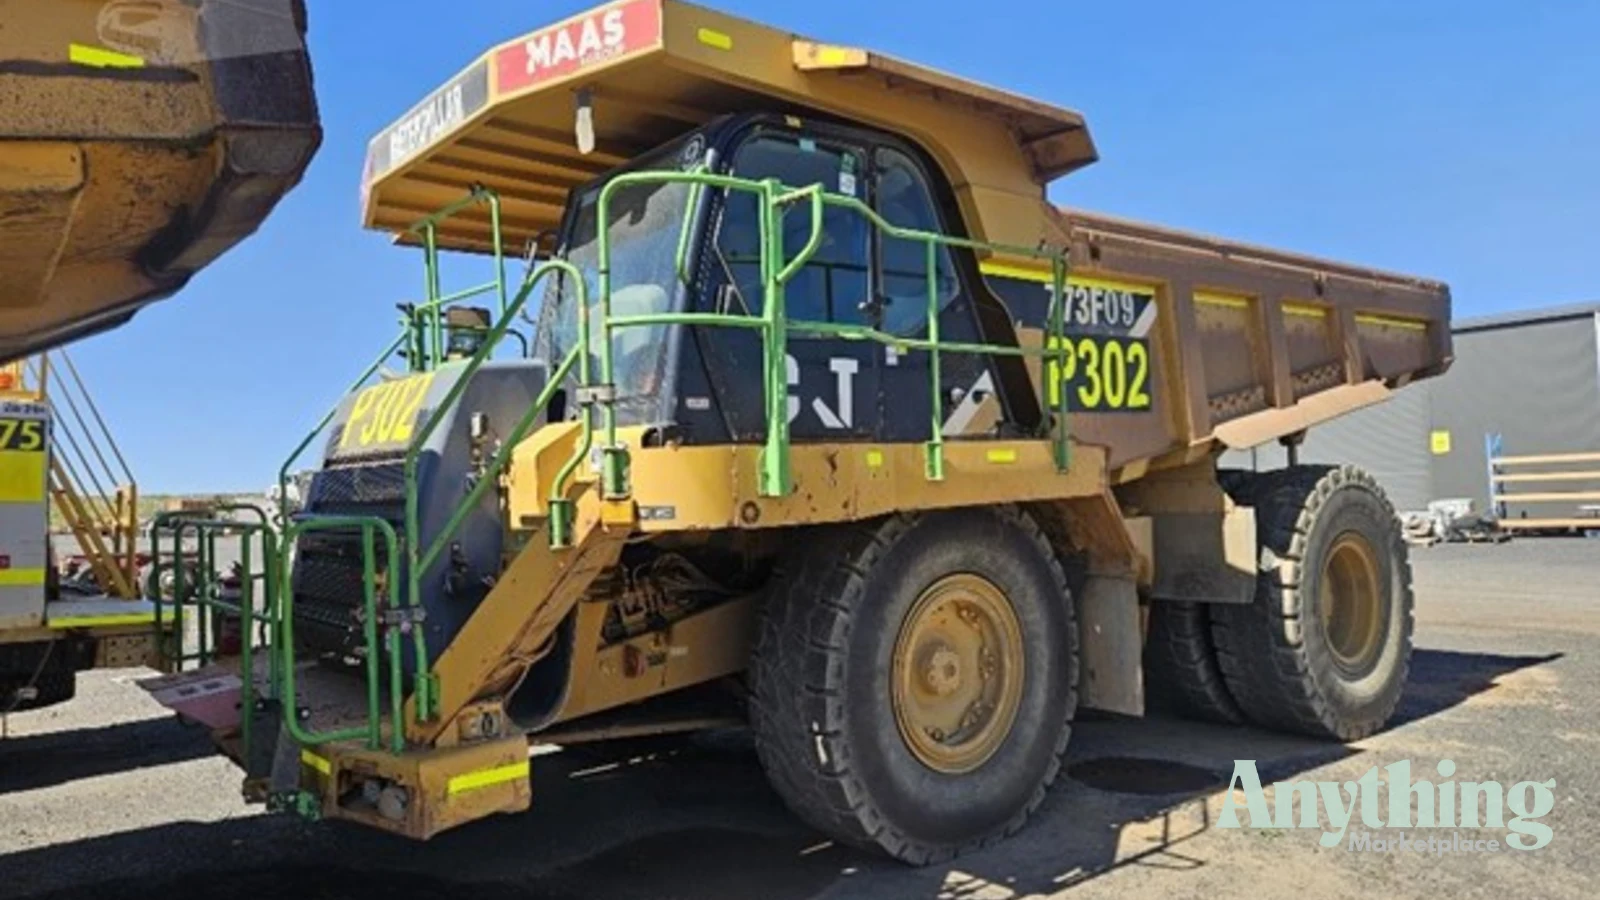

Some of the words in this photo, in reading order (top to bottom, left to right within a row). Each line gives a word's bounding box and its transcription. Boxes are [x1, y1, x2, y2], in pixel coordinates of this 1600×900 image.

[525, 9, 626, 75] MAAS
[1044, 284, 1135, 326] 773F09
[1048, 336, 1149, 408] P302
[0, 420, 41, 450] 75
[340, 372, 434, 448] P302
